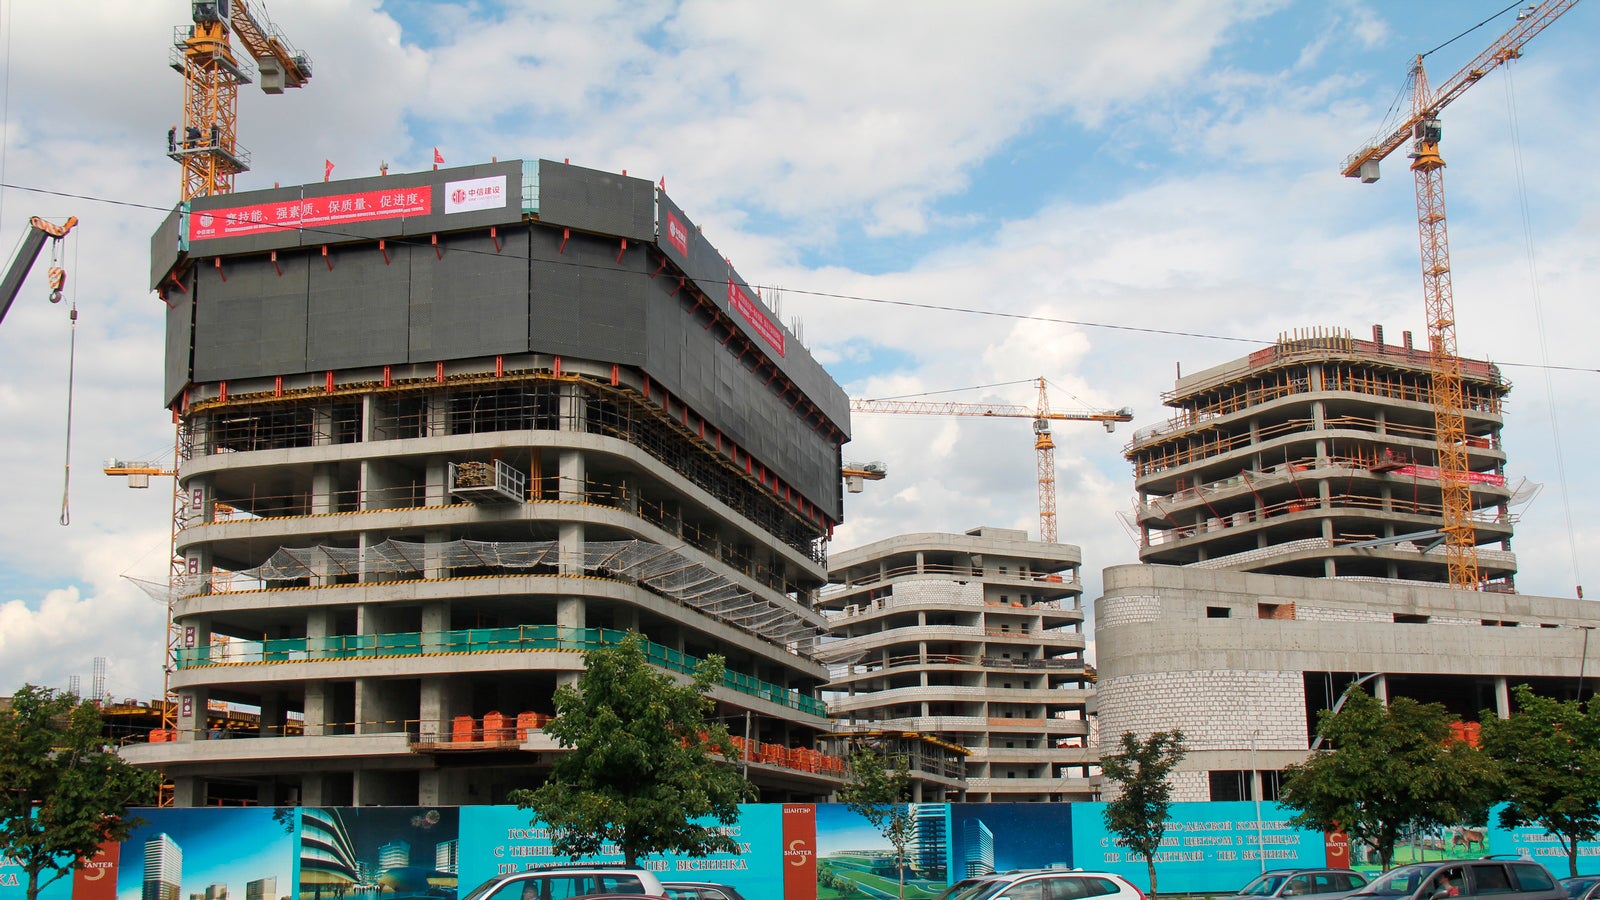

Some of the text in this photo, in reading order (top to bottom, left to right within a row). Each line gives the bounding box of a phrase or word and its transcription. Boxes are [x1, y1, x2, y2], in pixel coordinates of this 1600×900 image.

[468, 185, 500, 197] 中信建设
[494, 845, 505, 858] С
[676, 858, 748, 871] ВЕСНИНКА
